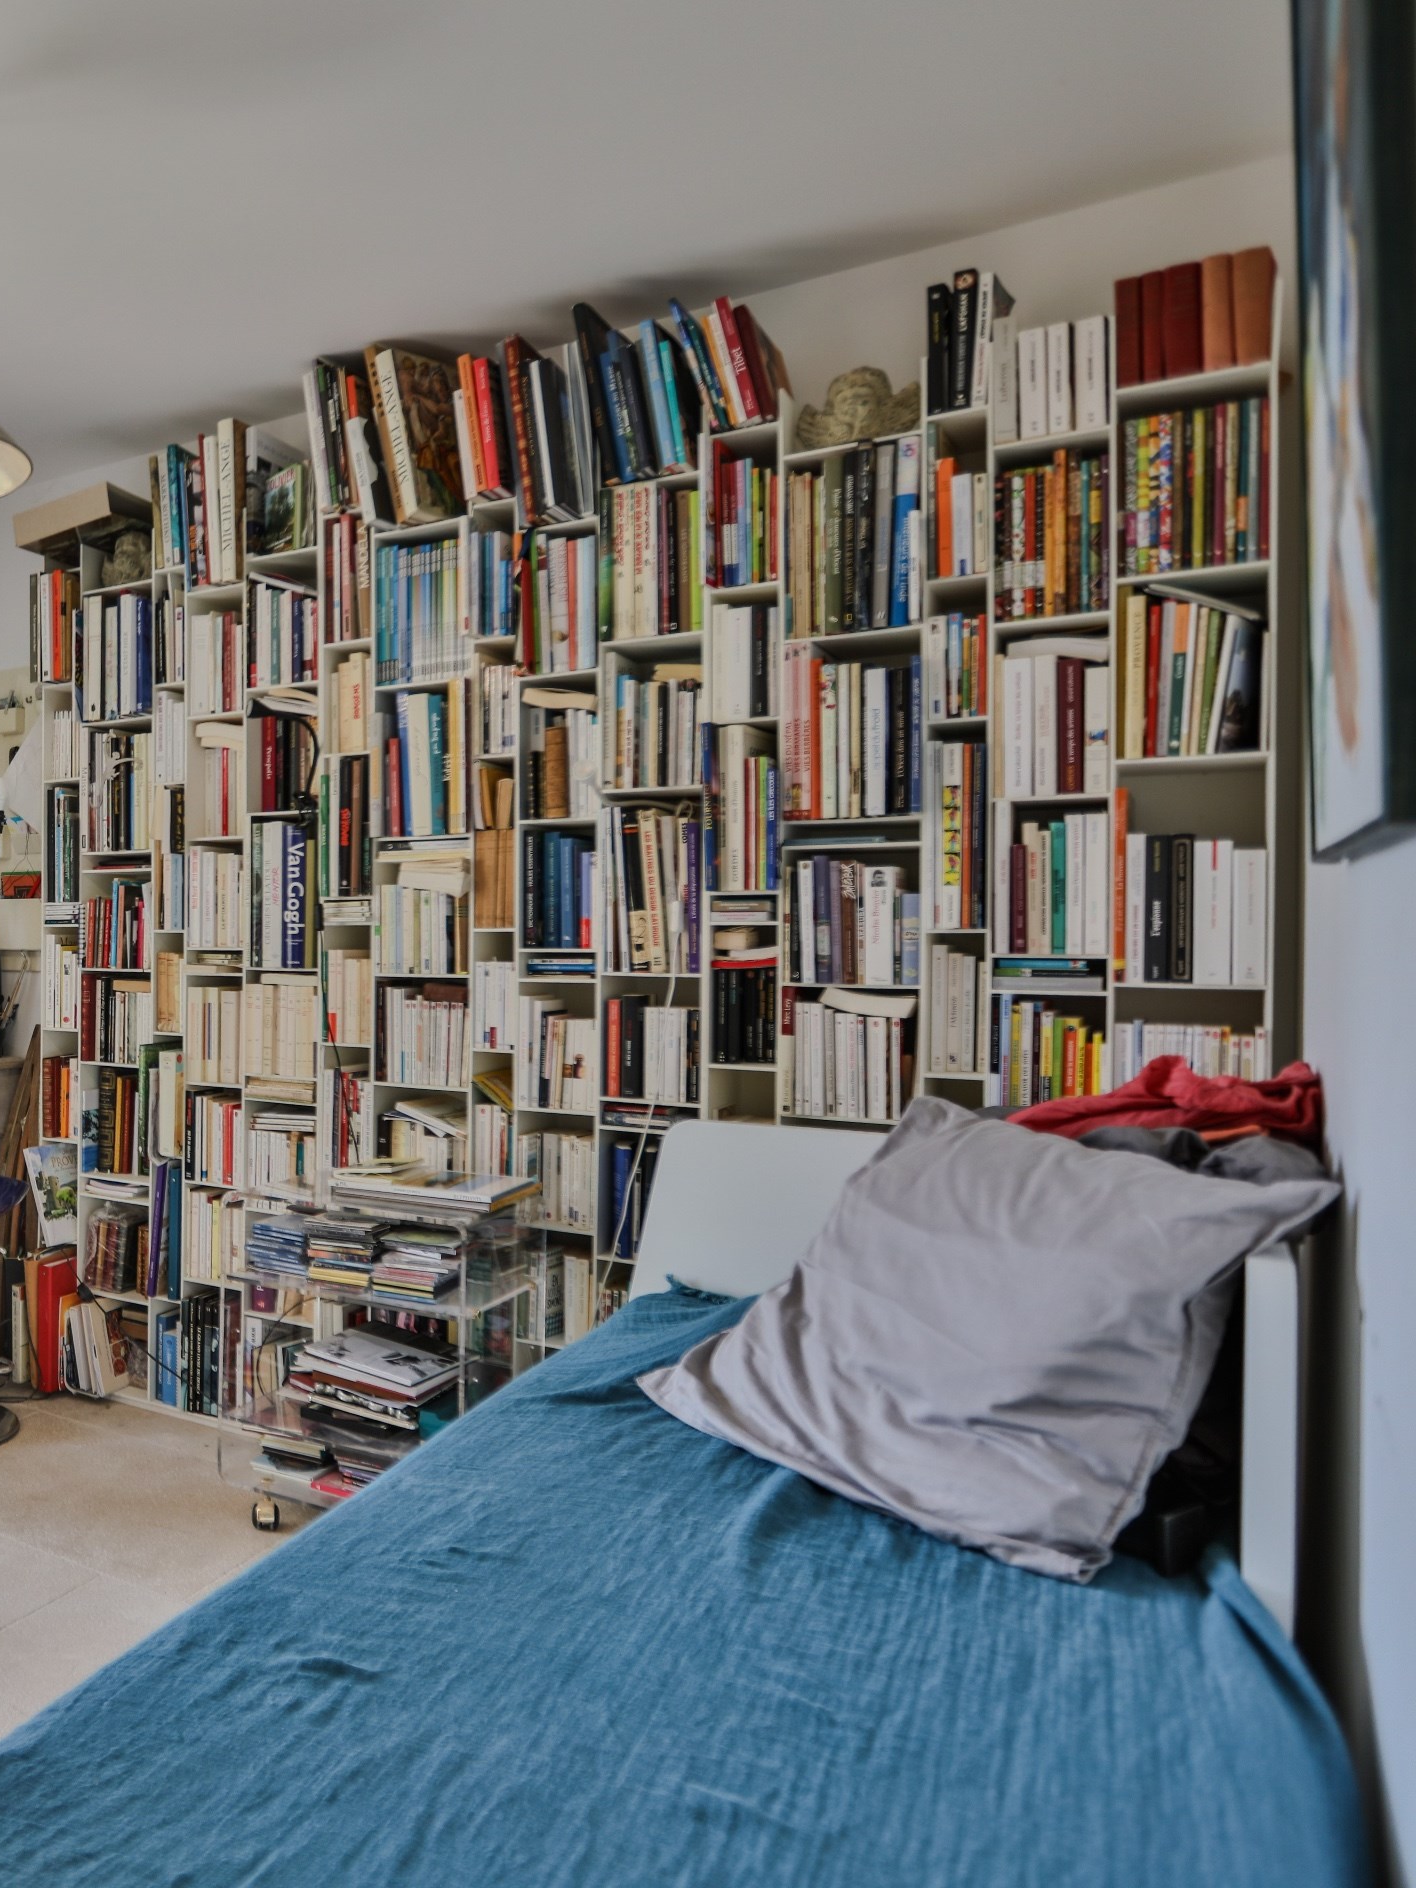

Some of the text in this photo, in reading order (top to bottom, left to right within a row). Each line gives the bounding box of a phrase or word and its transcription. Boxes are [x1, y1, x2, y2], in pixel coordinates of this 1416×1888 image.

[379, 369, 410, 486] MICHEL-ANGE
[219, 438, 234, 552] MICHEL-ANGE
[356, 523, 370, 589] MANDELA
[80, 766, 89, 798] Matisse
[263, 745, 274, 781] Persepolis
[283, 842, 306, 936] Van Gogh
[872, 918, 880, 944] Nicolas
[783, 999, 793, 1025] Marc Levy
